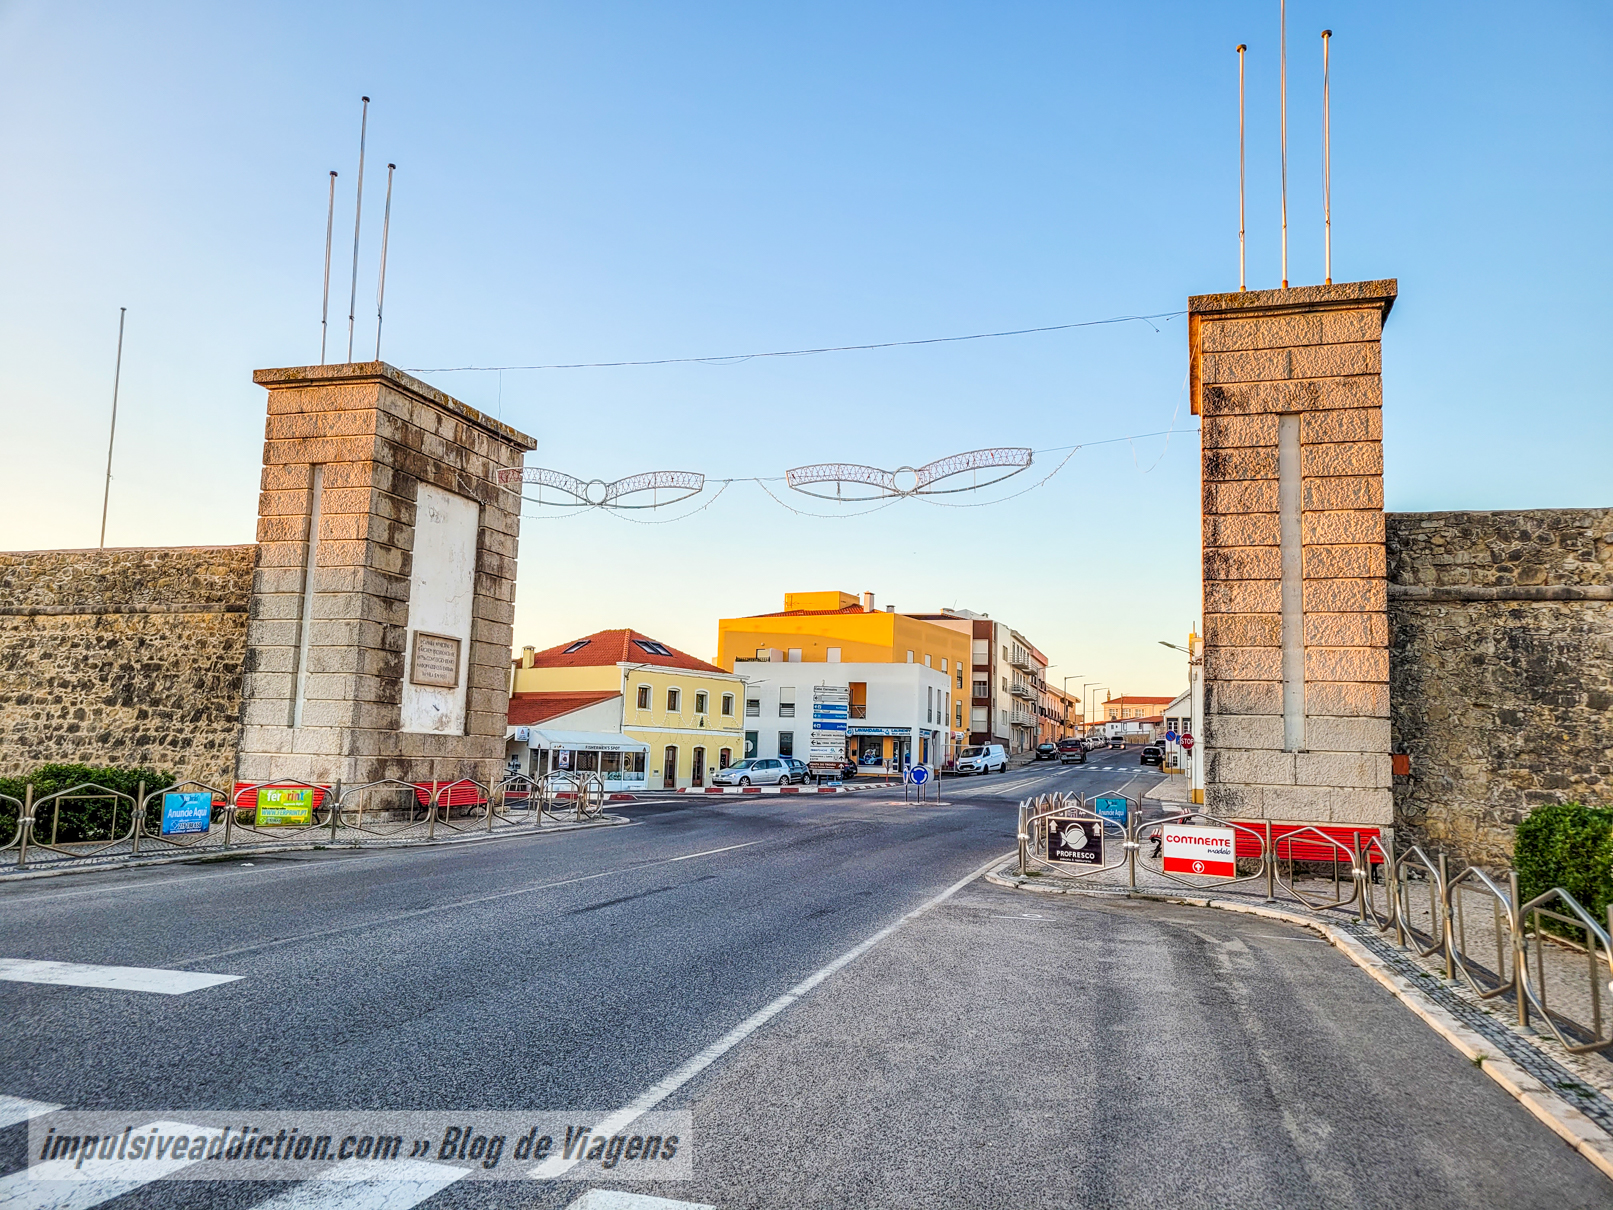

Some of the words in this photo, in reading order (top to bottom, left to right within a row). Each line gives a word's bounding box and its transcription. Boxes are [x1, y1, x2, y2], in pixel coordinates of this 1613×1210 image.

[267, 790, 304, 804] ferprint
[167, 807, 193, 818] Anuncie
[193, 806, 208, 818] Aqui
[1115, 809, 1124, 817] Aqui
[1166, 834, 1231, 847] CONTINENTE
[1056, 850, 1095, 860] PROFRESCO
